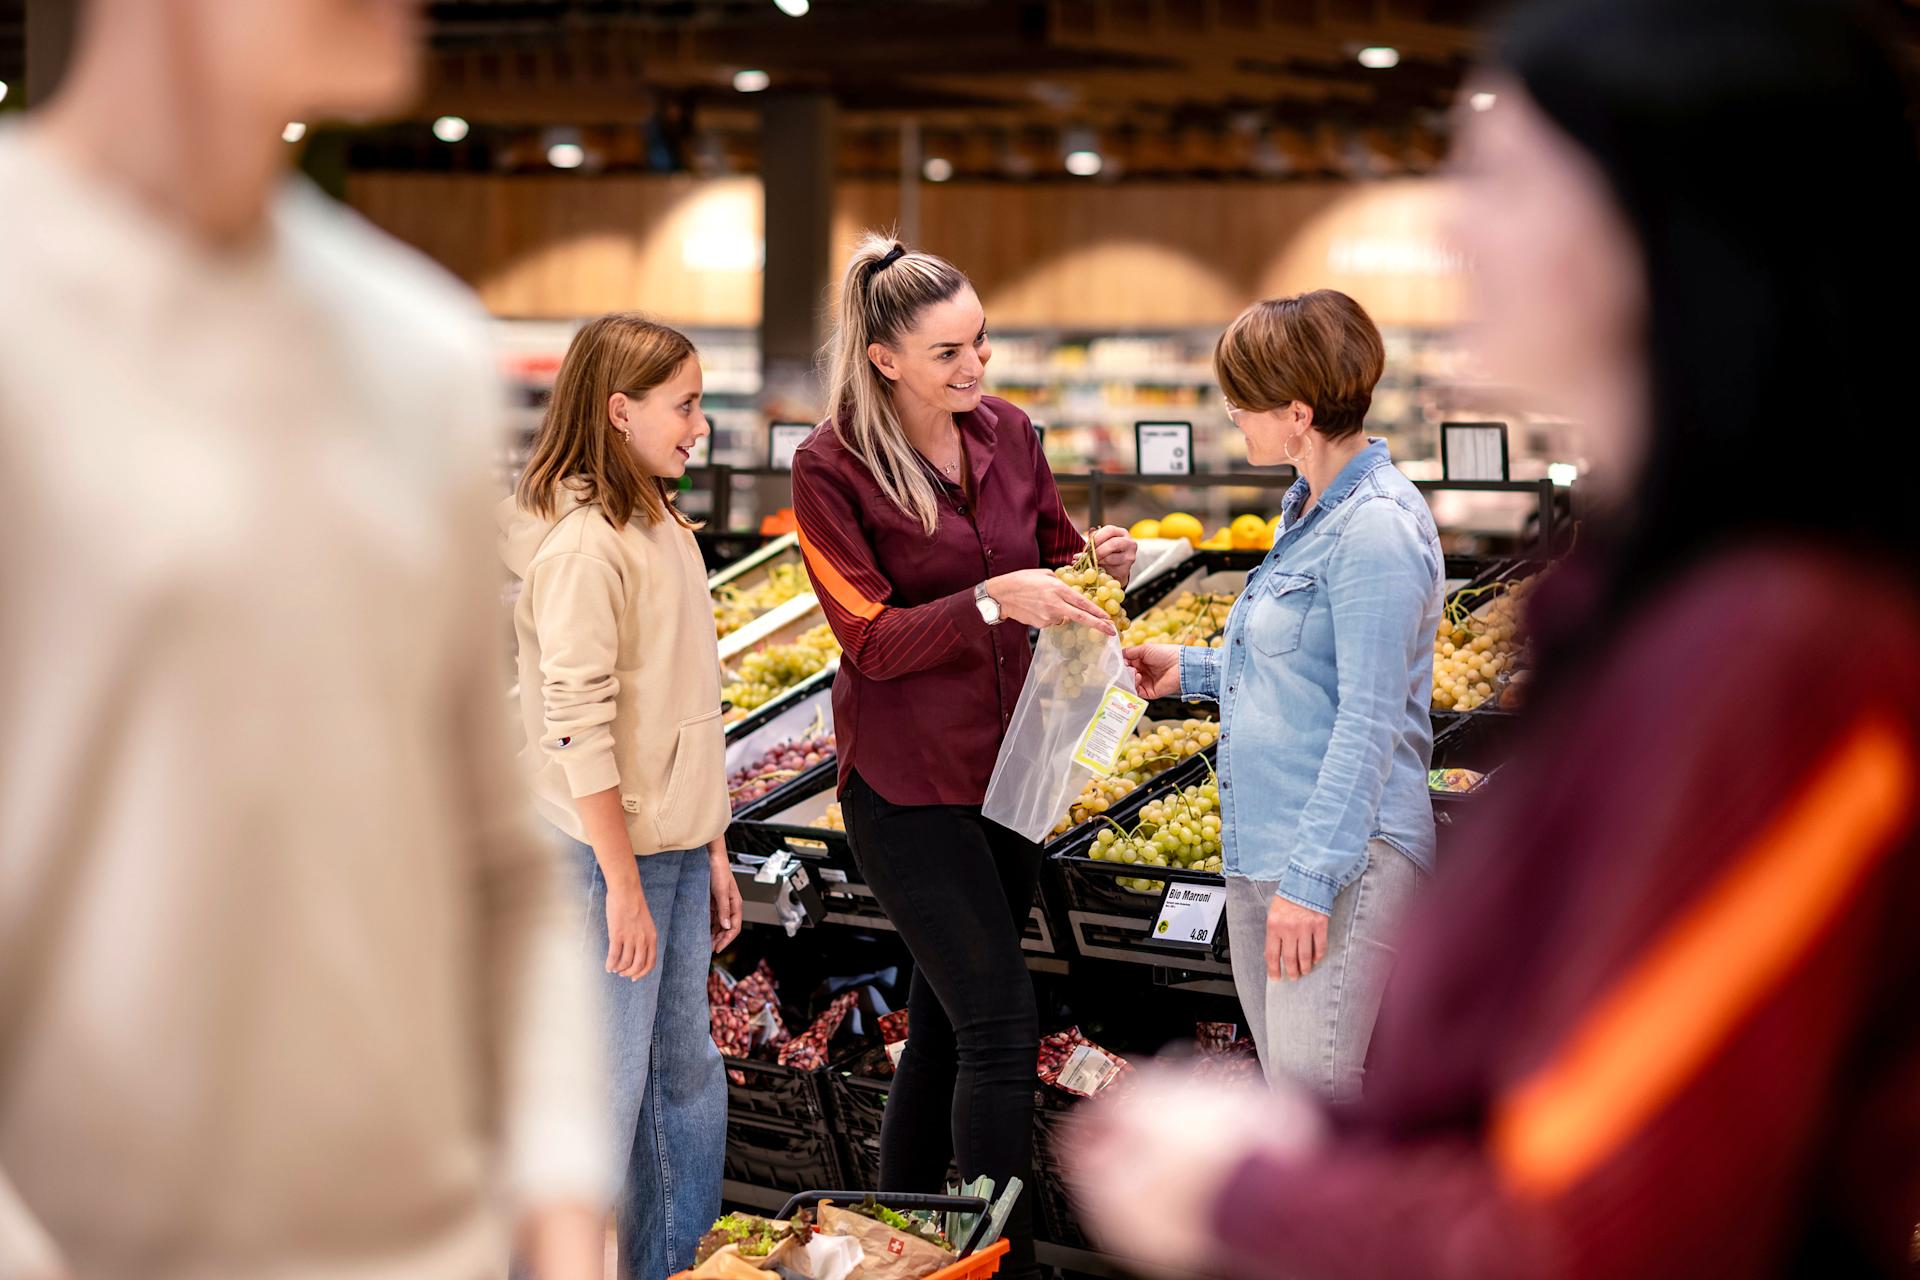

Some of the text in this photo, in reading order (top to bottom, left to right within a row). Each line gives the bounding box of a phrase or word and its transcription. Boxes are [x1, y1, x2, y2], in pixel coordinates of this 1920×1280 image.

[1169, 889, 1211, 902] Bio Marroni
[1190, 928, 1208, 941] 4.80
